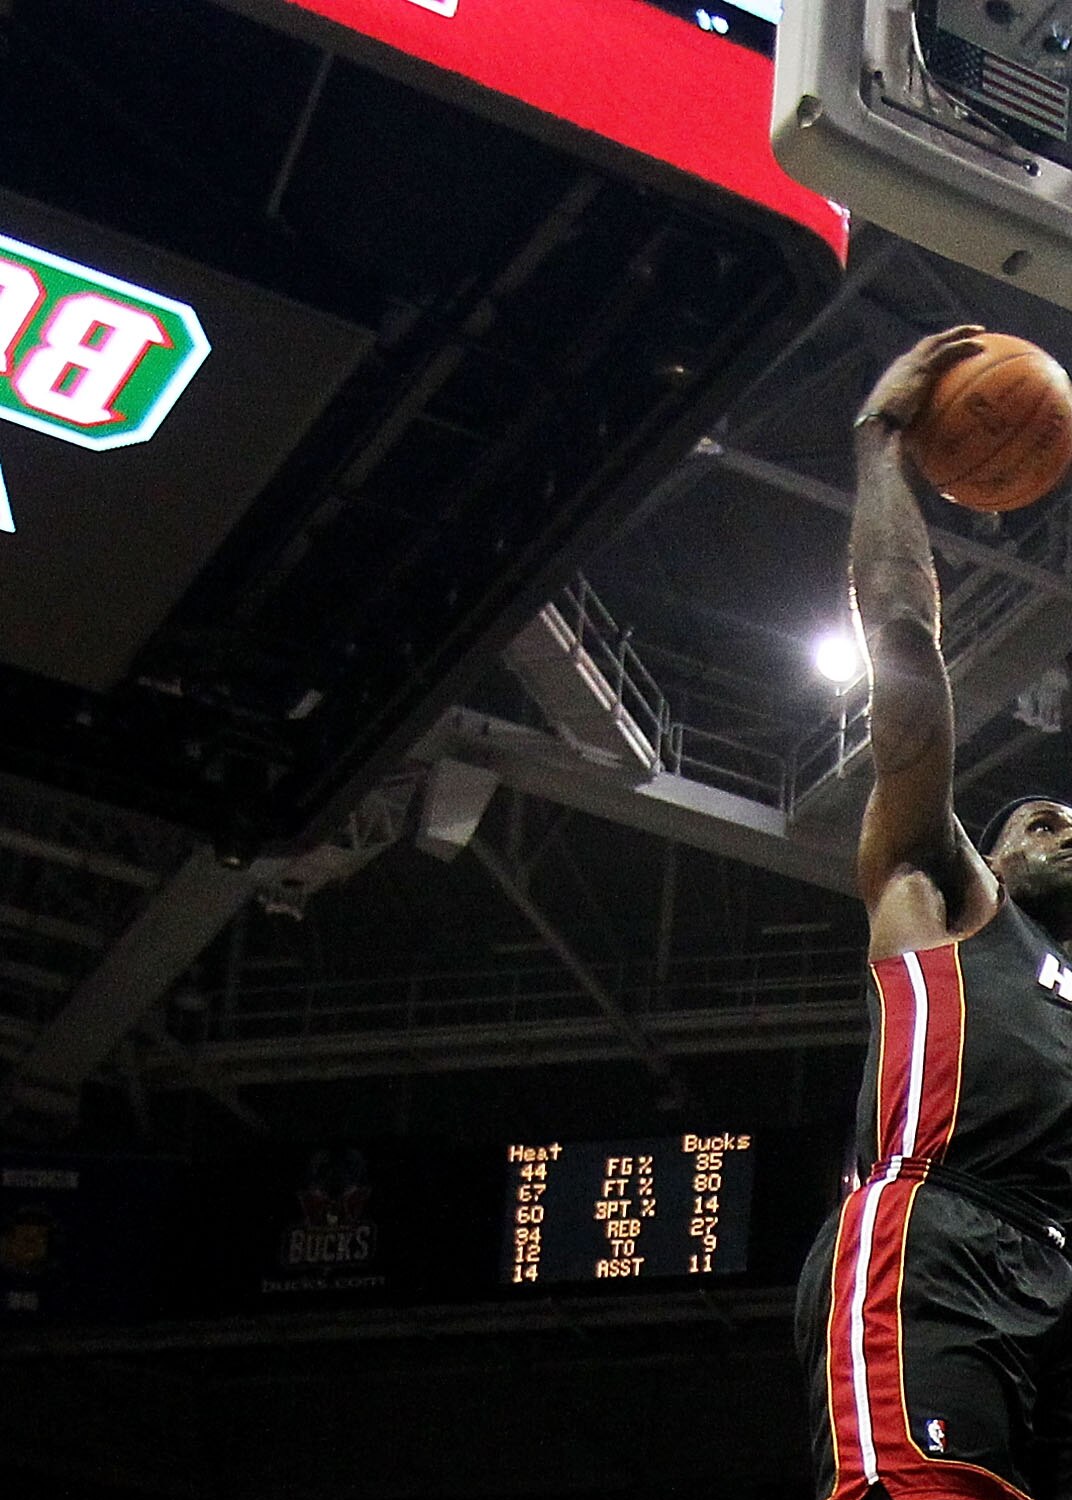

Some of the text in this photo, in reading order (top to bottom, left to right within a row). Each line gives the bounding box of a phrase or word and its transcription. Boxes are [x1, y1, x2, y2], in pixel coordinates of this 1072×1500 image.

[509, 1142, 562, 1162] Heat
[683, 1132, 751, 1152] Bucks
[521, 1153, 723, 1181] 44 FG % 35
[604, 1179, 629, 1197] FT
[639, 1178, 653, 1196] %
[693, 1173, 722, 1192] 80
[517, 1196, 719, 1224] 60 3PT % 14
[607, 1219, 641, 1238] REB
[690, 1217, 718, 1236] 27
[289, 1225, 371, 1263] BUCKS
[515, 1235, 717, 1263] 12 TO 9
[513, 1254, 713, 1283] 14 ASST 11
[262, 1275, 386, 1294] bucks.com
